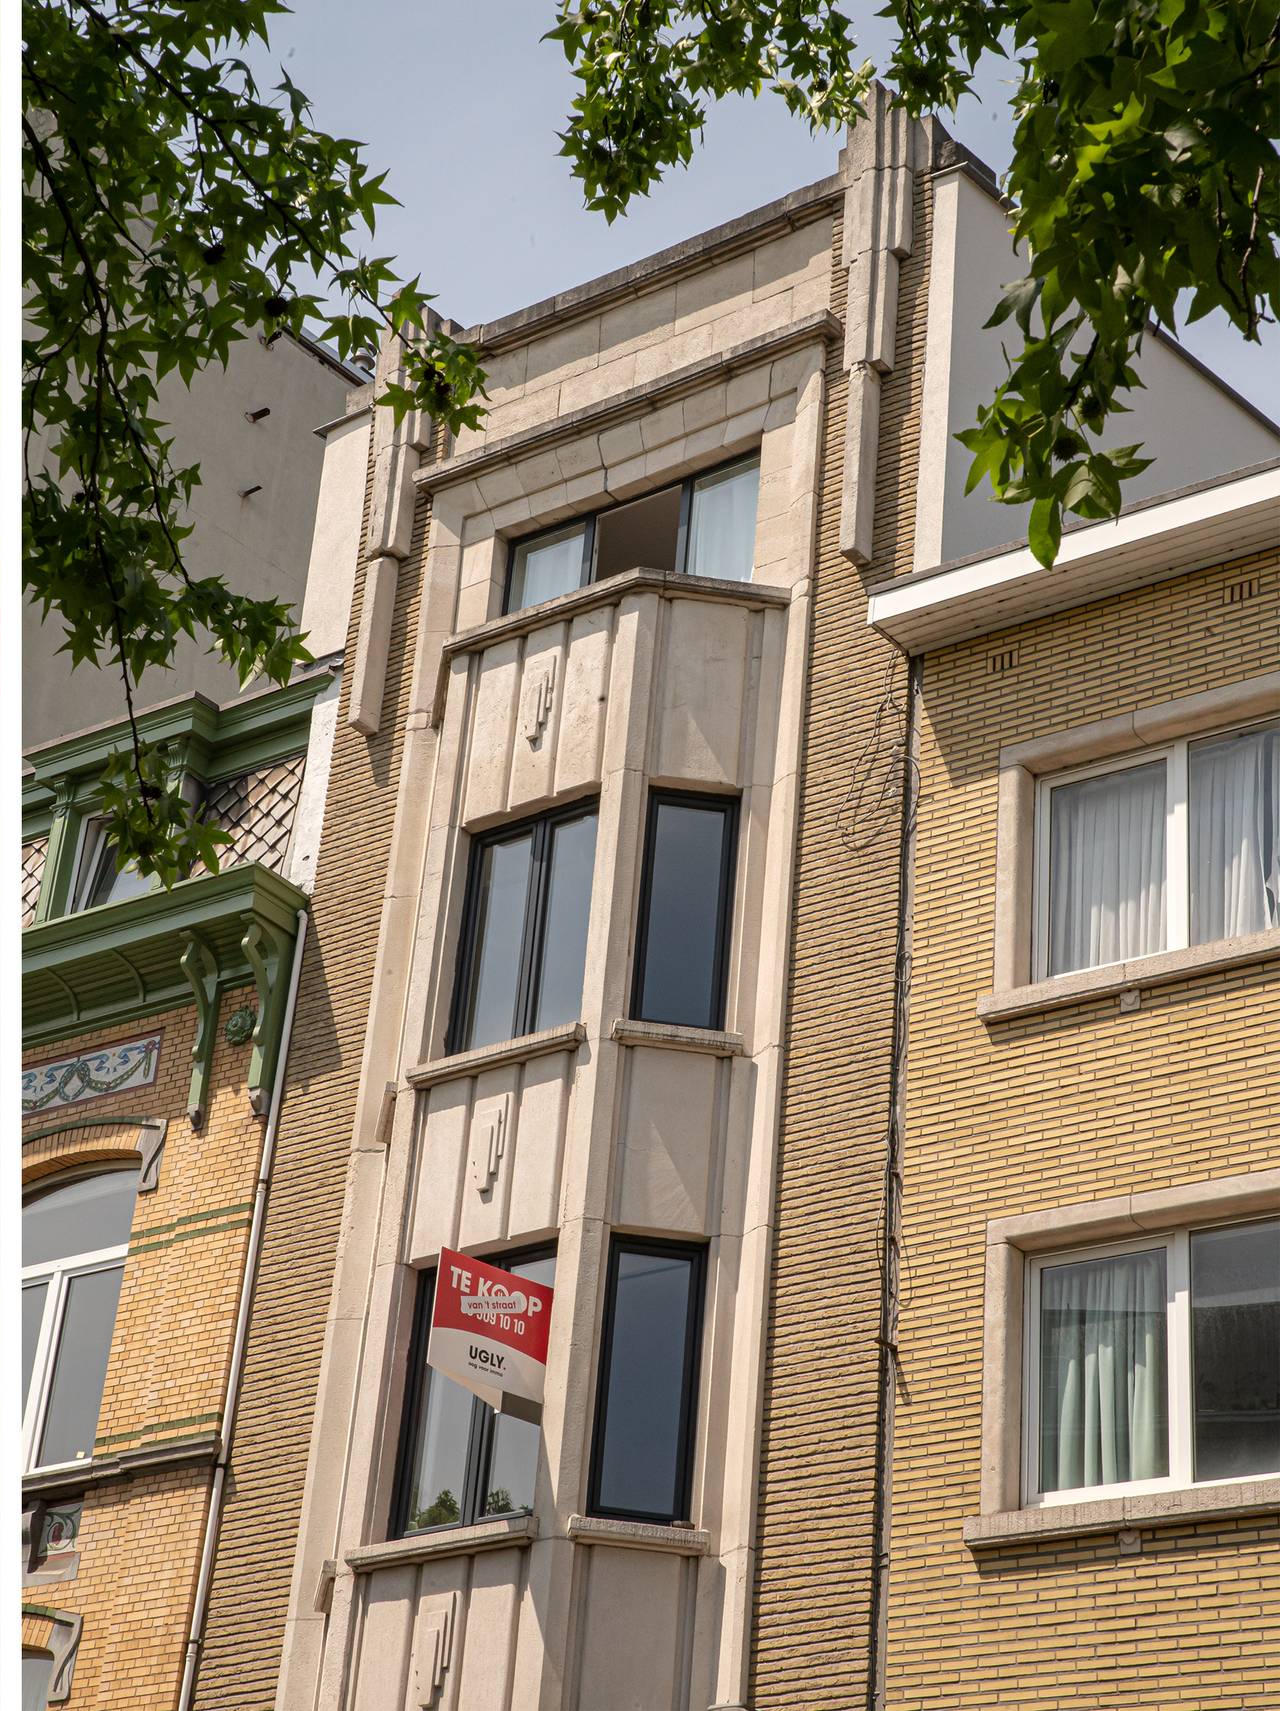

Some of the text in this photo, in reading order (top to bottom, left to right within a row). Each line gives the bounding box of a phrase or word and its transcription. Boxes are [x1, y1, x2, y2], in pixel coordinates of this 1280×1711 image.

[450, 1265, 472, 1294] TE
[467, 1301, 483, 1309] van
[492, 1301, 516, 1310] straat
[500, 1314, 511, 1330] 10
[513, 1319, 525, 1335] 10
